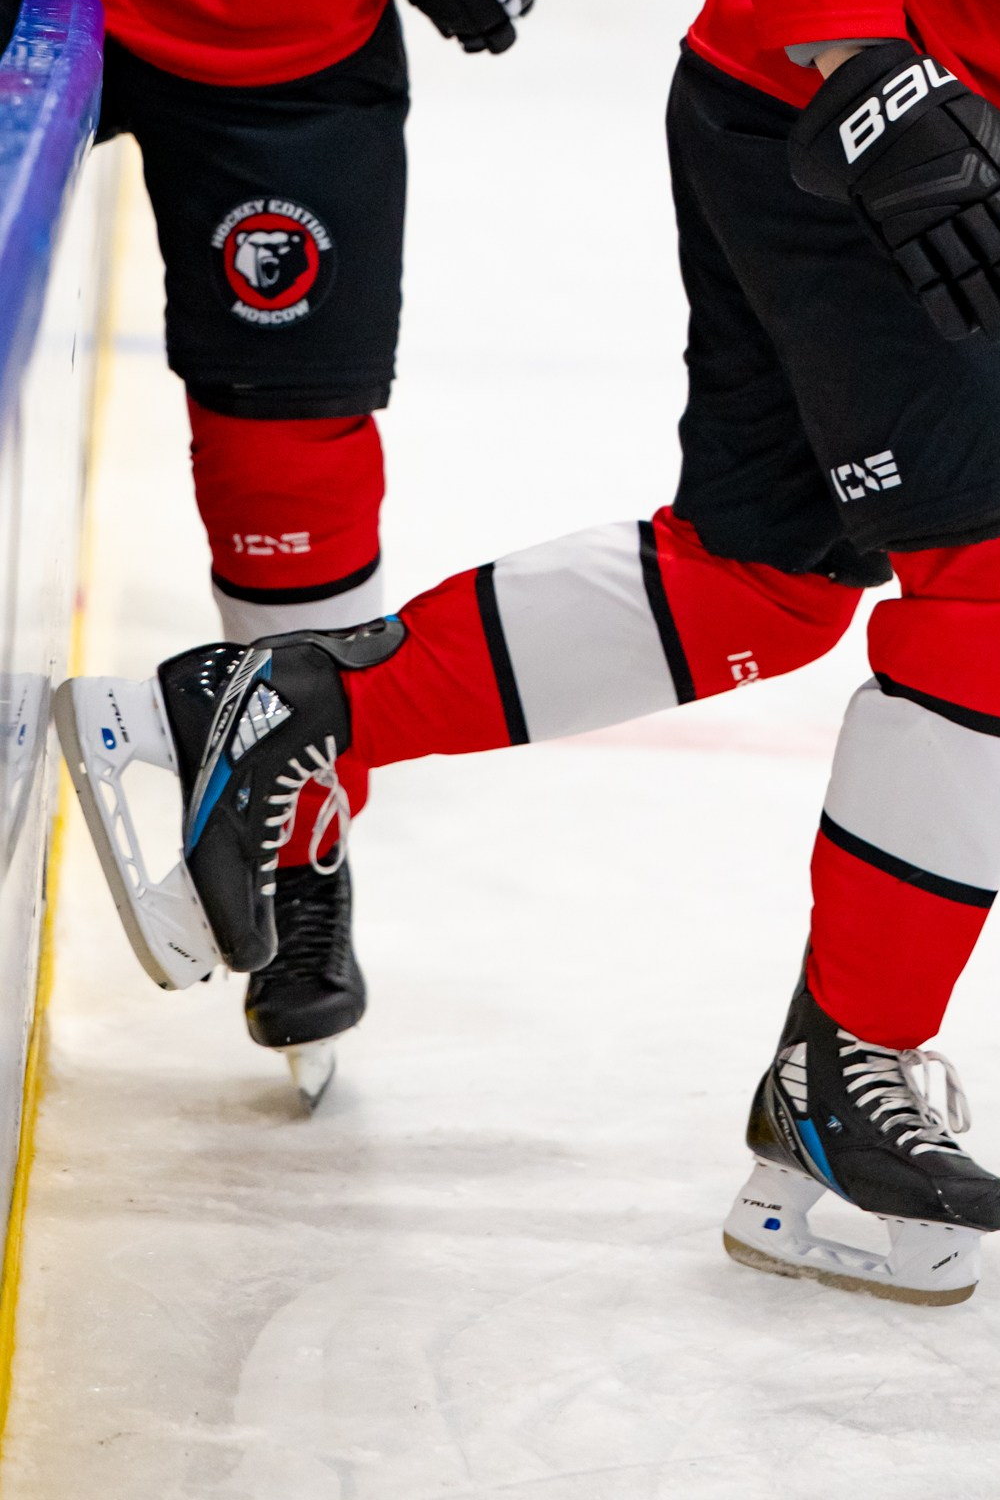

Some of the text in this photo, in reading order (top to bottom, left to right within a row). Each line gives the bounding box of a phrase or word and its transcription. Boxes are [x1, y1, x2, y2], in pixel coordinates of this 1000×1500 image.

[268, 199, 332, 251] EDITION
[231, 298, 310, 324] MOSCOW
[742, 1198, 783, 1211] TRUE
